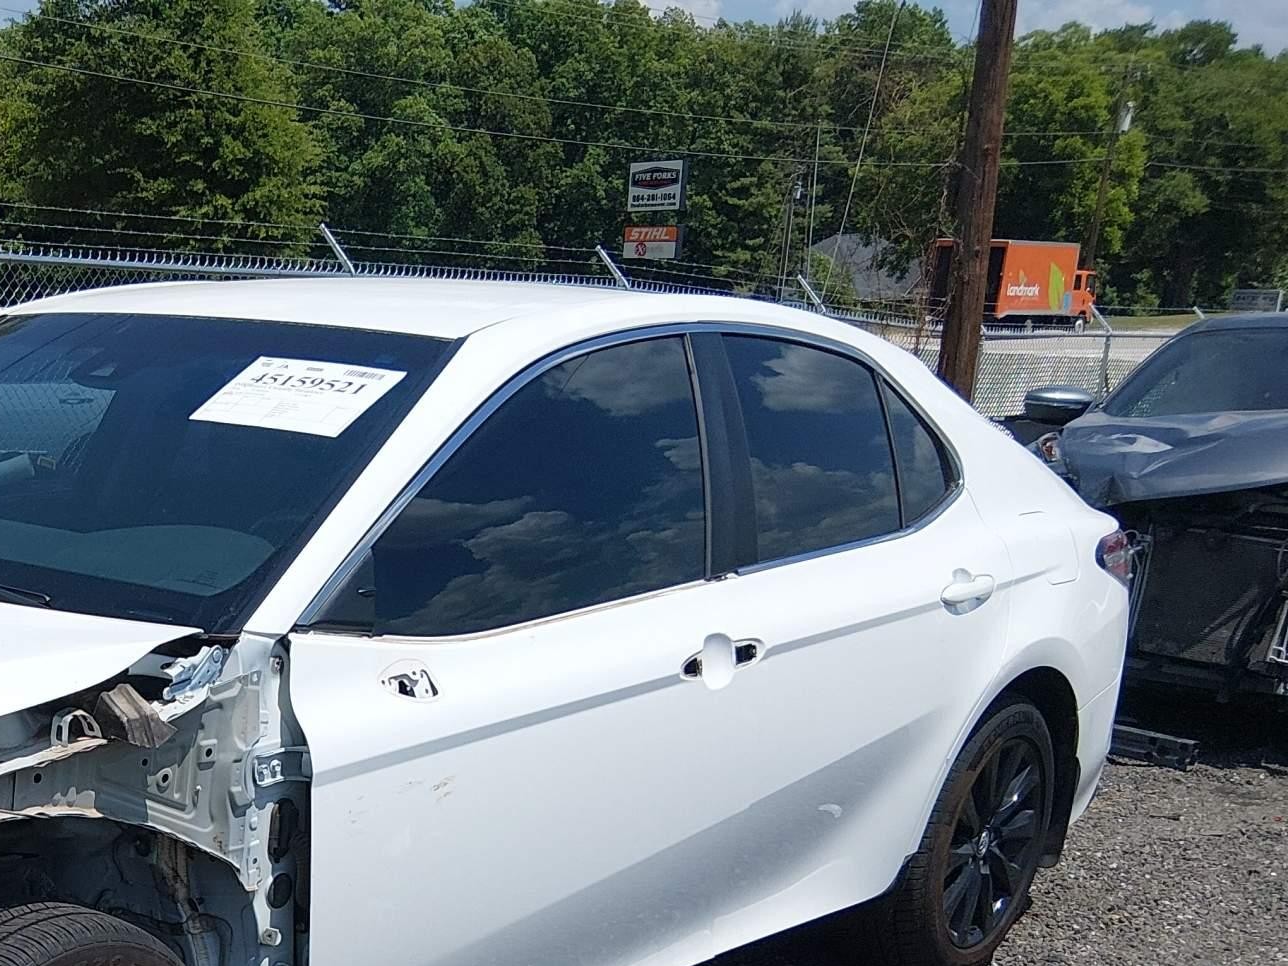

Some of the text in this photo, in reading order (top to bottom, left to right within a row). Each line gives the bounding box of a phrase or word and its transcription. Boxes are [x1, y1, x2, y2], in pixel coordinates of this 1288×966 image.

[635, 172, 677, 181] FIVE FORKS
[630, 227, 669, 240] STIHL
[1007, 283, 1040, 296] landmark
[251, 372, 368, 394] 45159521
